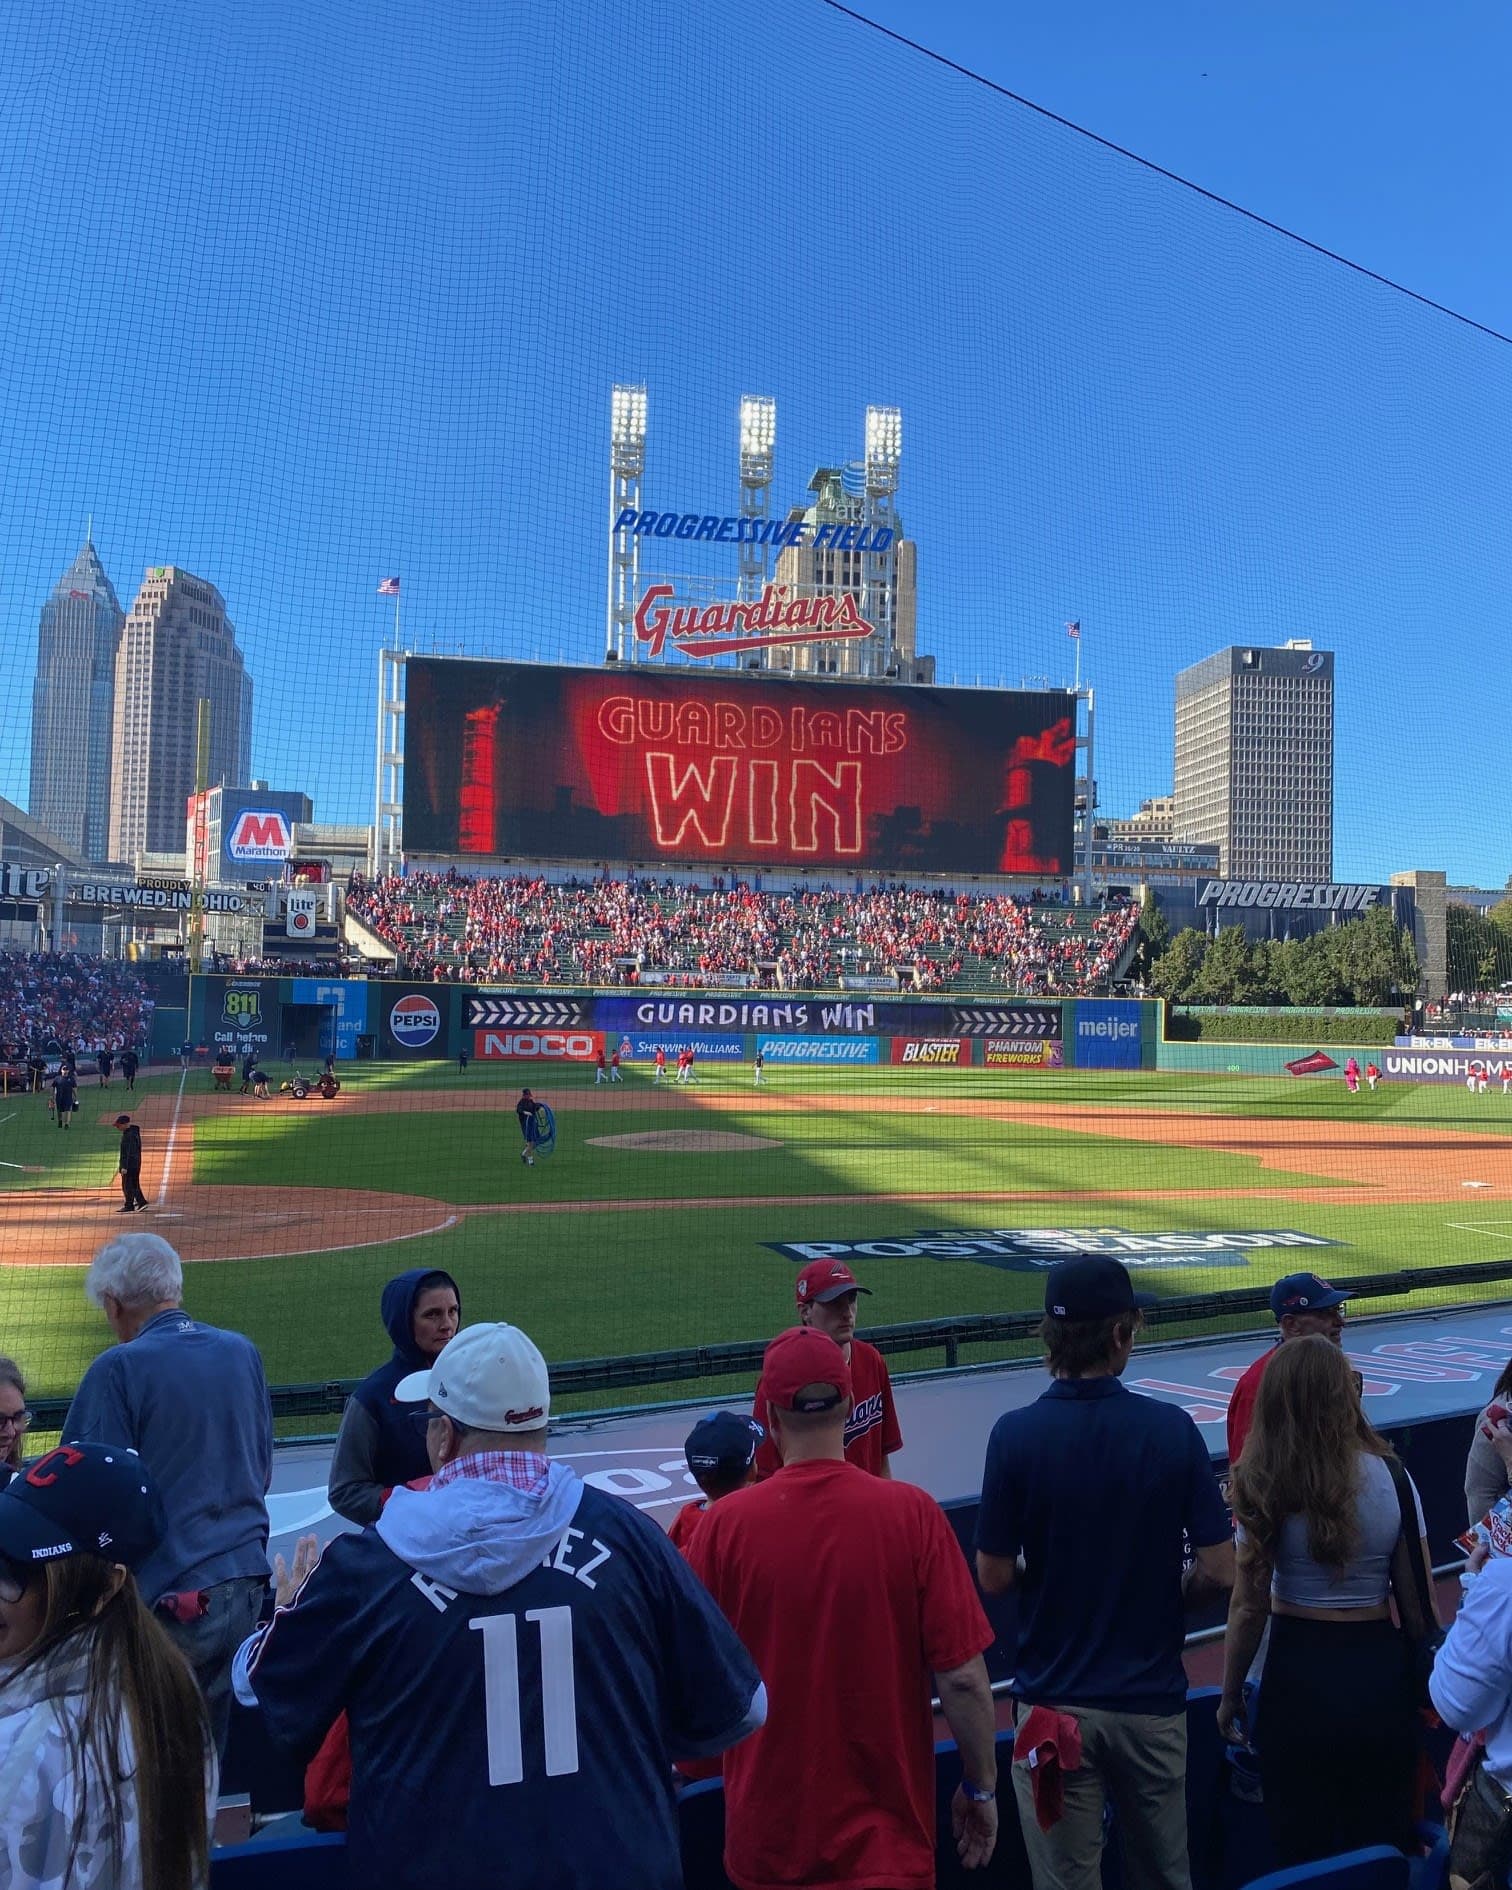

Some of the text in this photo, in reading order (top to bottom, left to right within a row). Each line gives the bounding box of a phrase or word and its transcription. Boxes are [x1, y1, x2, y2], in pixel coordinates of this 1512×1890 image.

[612, 509, 894, 552] PROGRESSIVE FIELD
[633, 583, 864, 659] Guardians
[597, 696, 907, 755] GUARDIANS
[645, 751, 862, 853] WIN
[237, 815, 286, 847] M
[235, 847, 287, 856] Marathon
[138, 878, 191, 890] PROUDLY
[1199, 880, 1382, 910] PROGRESSIVE
[290, 898, 314, 913] Lite
[227, 993, 257, 1015] 811
[393, 1015, 437, 1027] PEPSI
[637, 1003, 875, 1031] GUARDIANS WIN
[214, 1031, 233, 1042] Call
[1078, 1017, 1138, 1041] meijer
[484, 1034, 593, 1056] NOCO
[760, 1041, 871, 1059] PROGRESSIVE
[902, 1043, 960, 1062] BLASTER
[987, 1040, 1043, 1052] PHANTOM
[986, 1053, 1042, 1064] FIREWORKS
[782, 1231, 1330, 1259] POSTSEASON
[26, 1446, 86, 1488] C
[31, 1542, 73, 1559] INDIANS
[468, 1605, 579, 1787] 11
